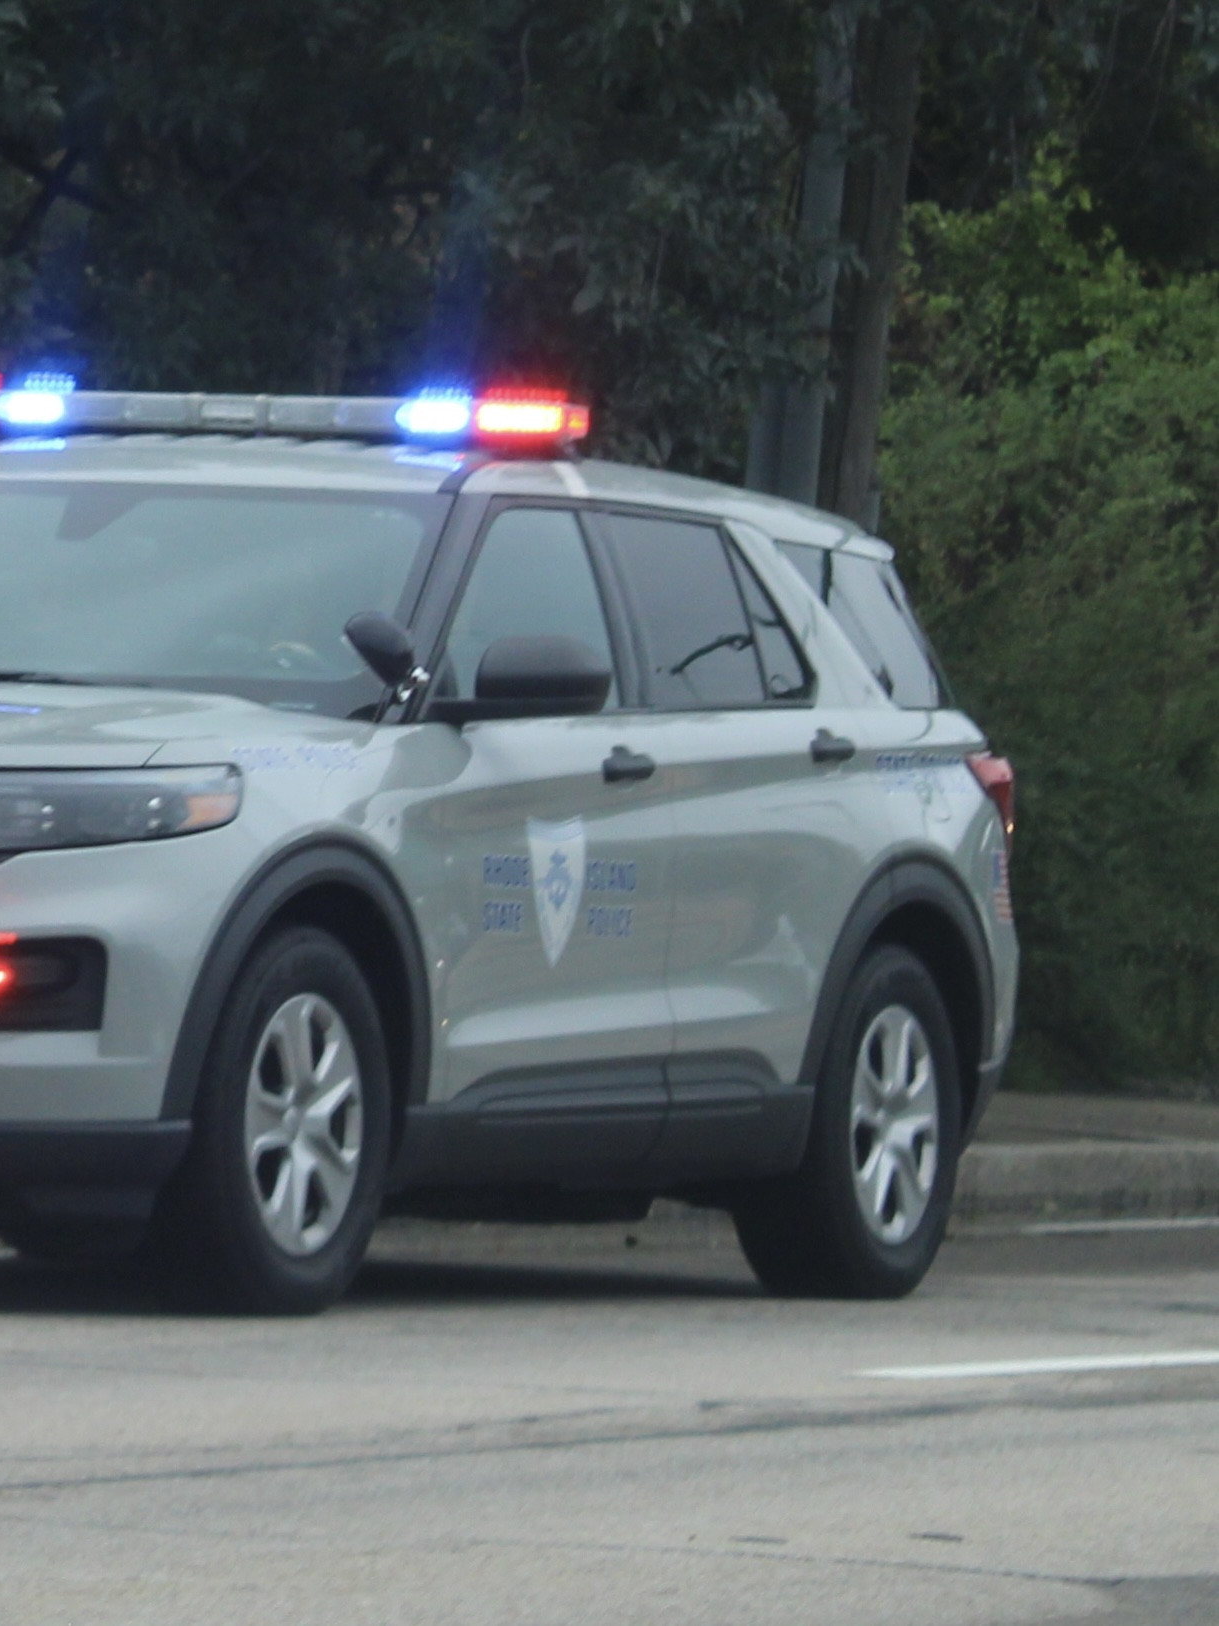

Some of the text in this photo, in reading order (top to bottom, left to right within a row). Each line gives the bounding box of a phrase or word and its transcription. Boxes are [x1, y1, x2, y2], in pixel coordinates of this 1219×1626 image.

[482, 855, 637, 892] RHODE ISLAND
[482, 900, 634, 938] STATE POLICE
